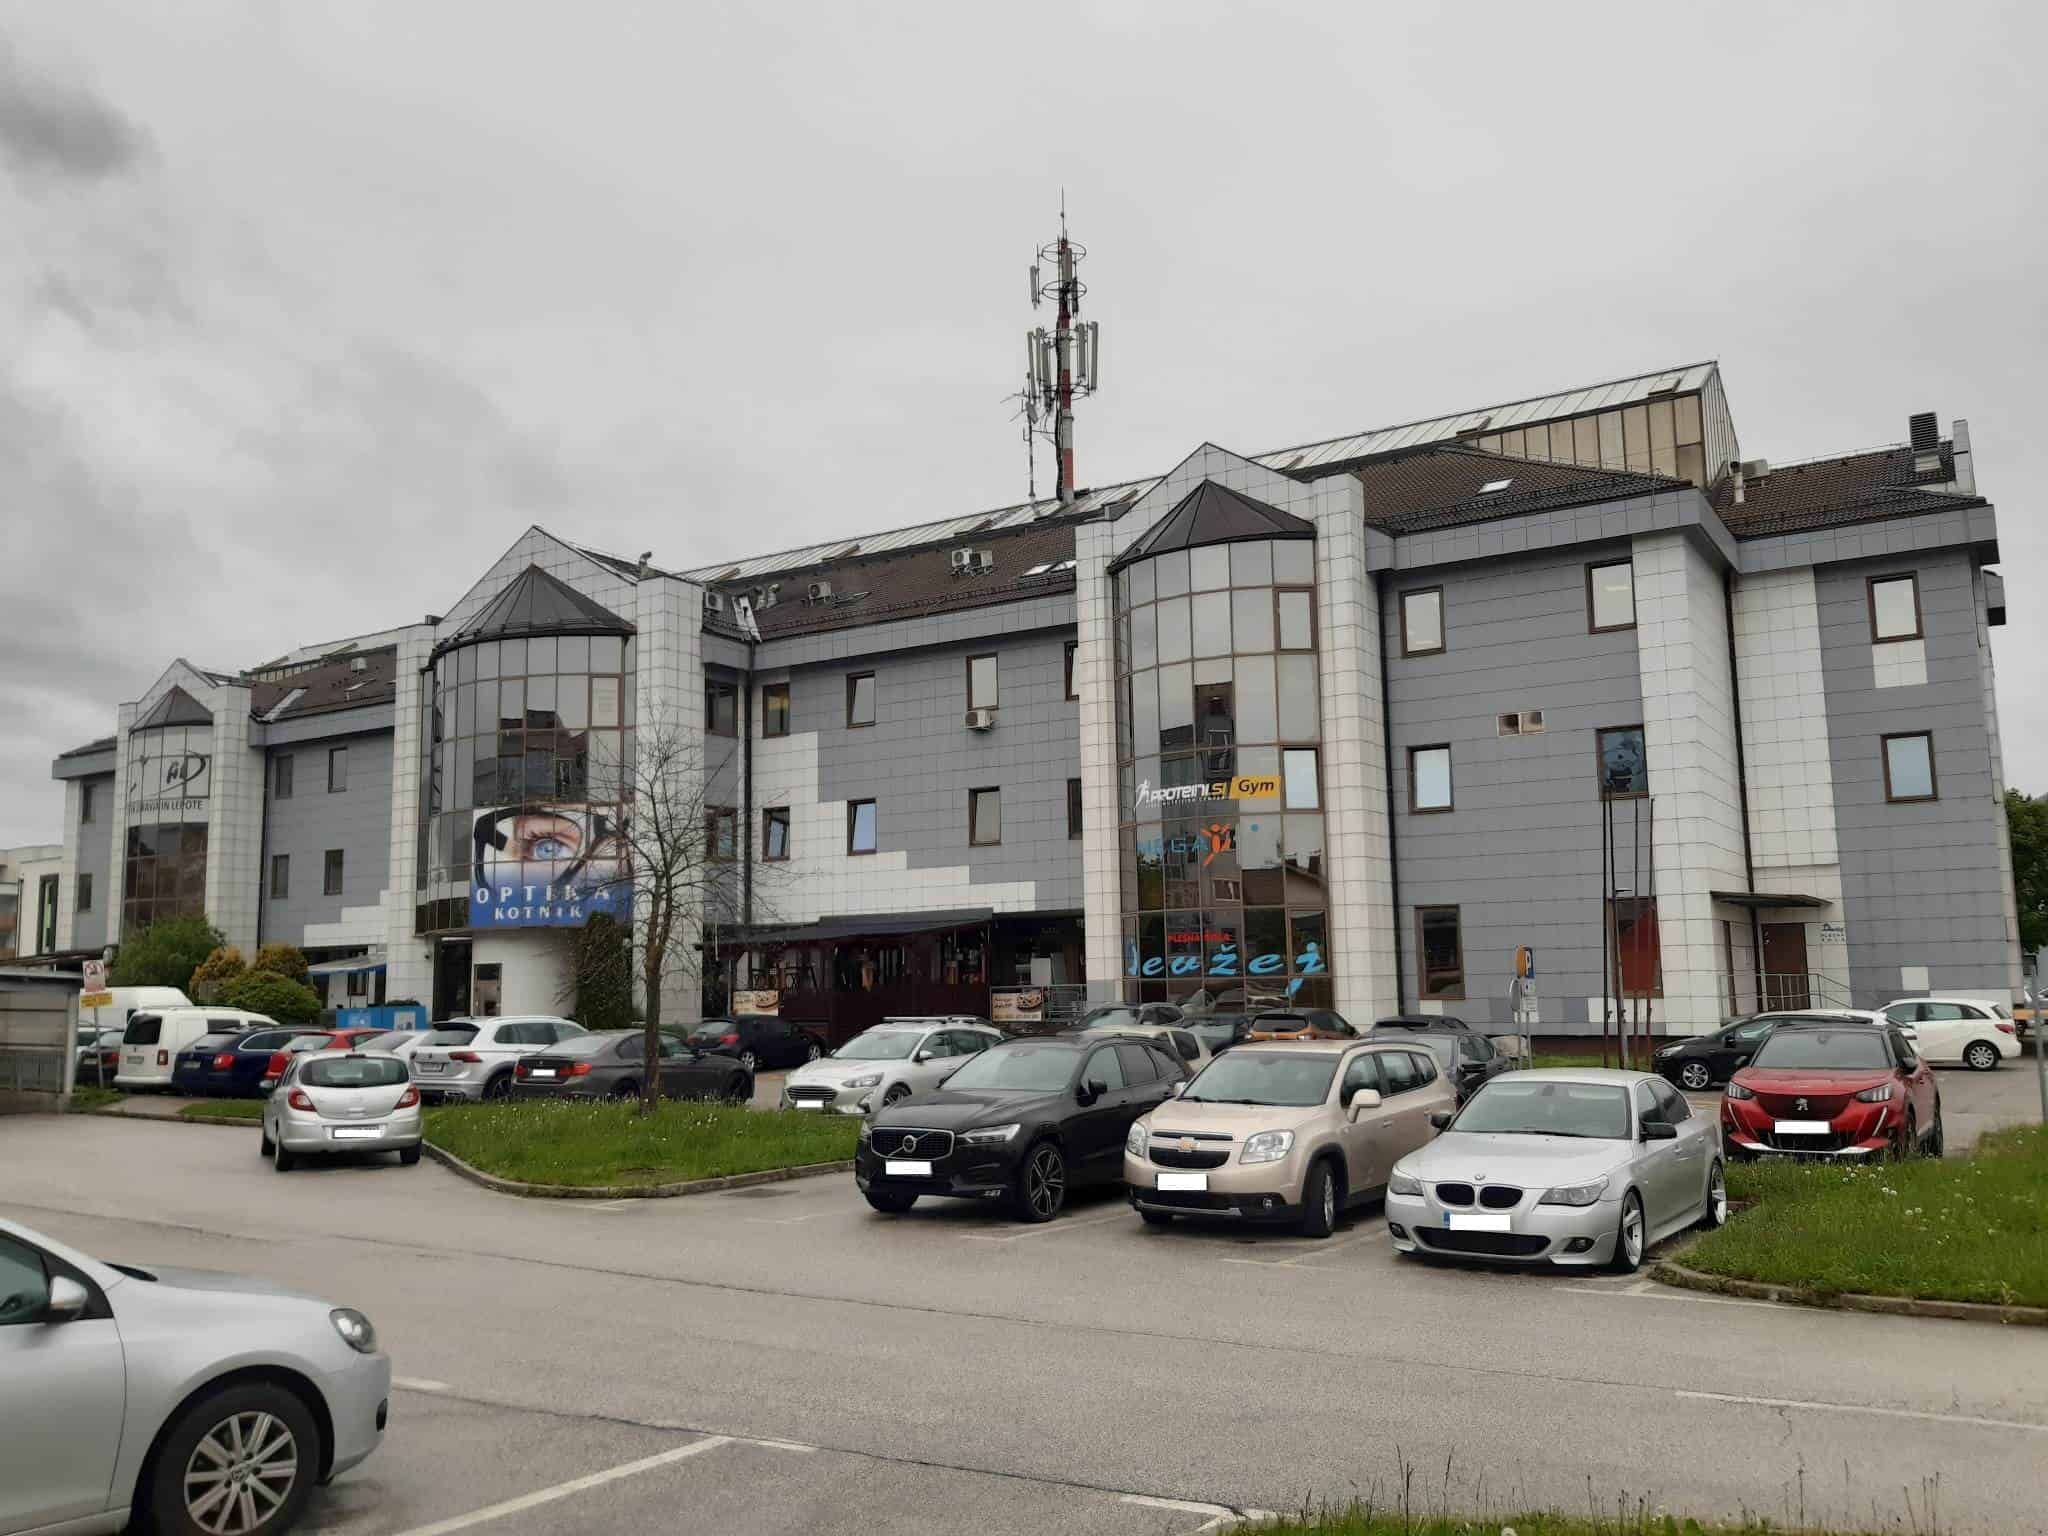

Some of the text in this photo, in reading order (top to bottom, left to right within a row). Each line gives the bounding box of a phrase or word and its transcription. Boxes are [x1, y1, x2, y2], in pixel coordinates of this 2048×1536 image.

[1239, 779, 1274, 795] Gym
[476, 885, 610, 904] OPTIKA
[495, 905, 583, 920] KOTNIK
